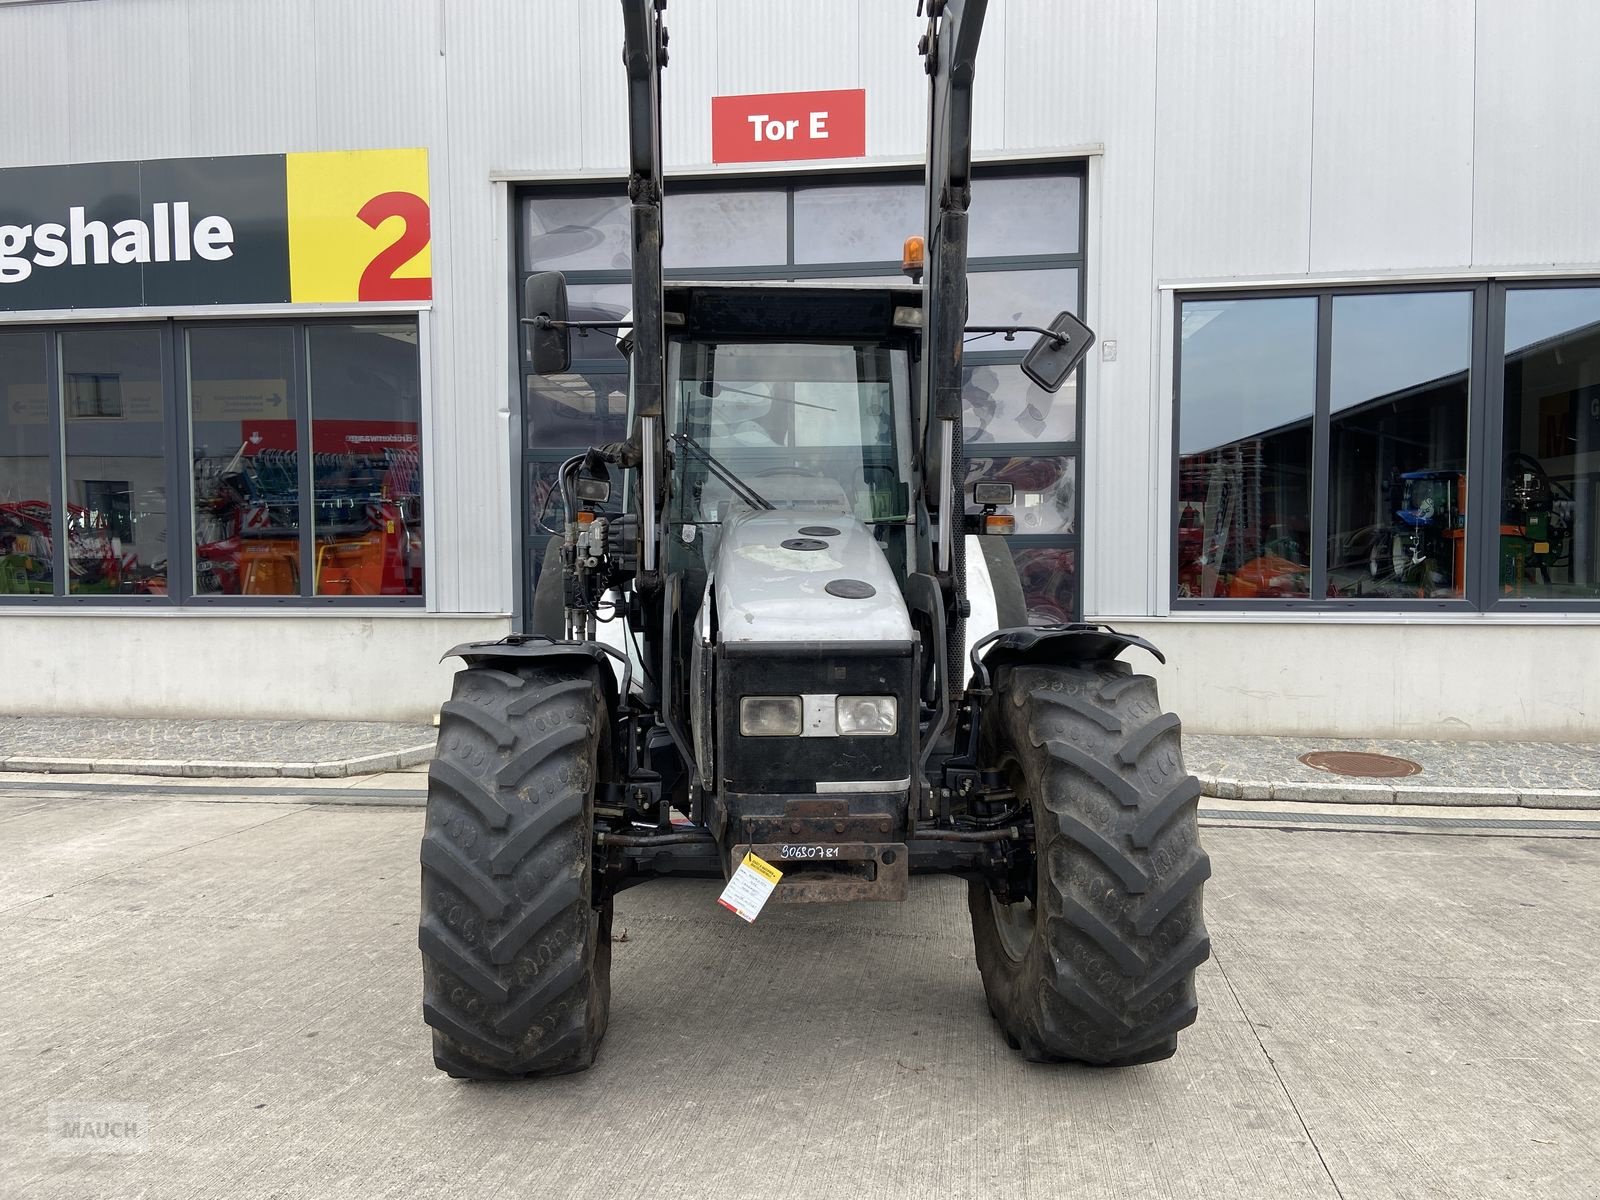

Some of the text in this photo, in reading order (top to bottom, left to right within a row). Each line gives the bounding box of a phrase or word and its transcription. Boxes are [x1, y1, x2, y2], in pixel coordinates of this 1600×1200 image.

[748, 112, 828, 141] Tor E
[0, 191, 433, 301] gshalle 2
